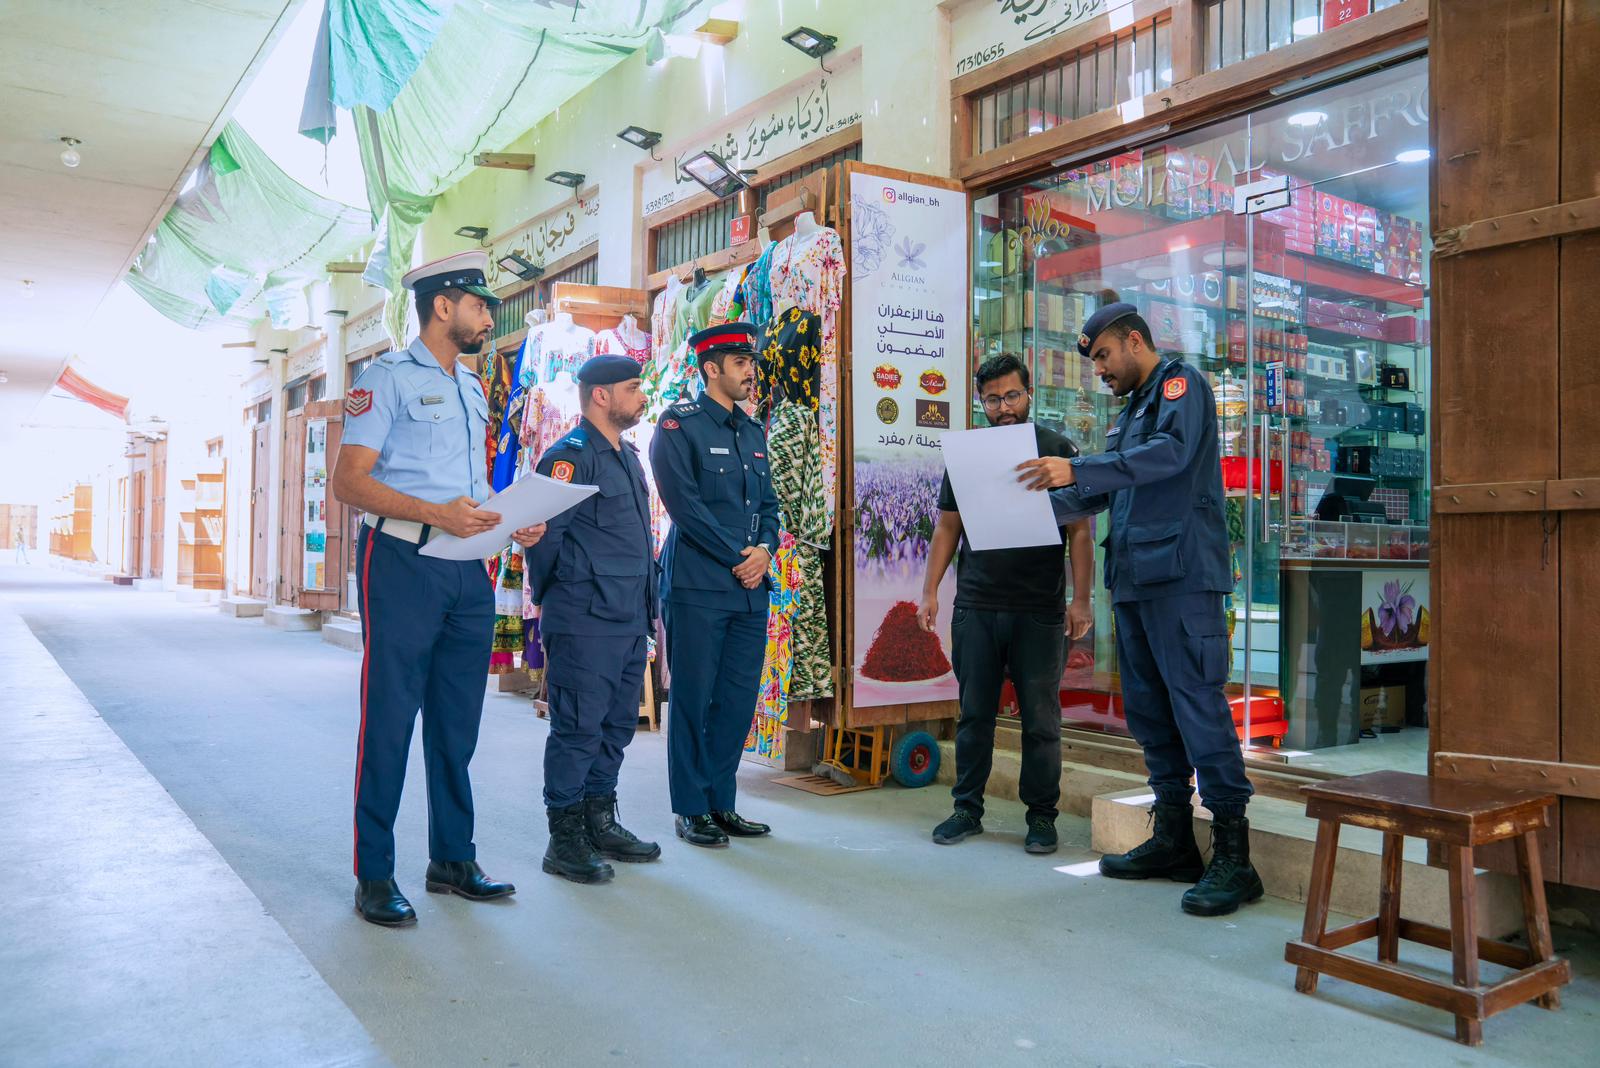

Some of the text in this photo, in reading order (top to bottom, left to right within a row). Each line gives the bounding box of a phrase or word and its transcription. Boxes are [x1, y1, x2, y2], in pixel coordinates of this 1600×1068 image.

[1339, 7, 1352, 21] 22
[956, 42, 1005, 75] 17310655
[898, 193, 940, 207] allgian_bh
[891, 272, 925, 284] ALLGIAN
[878, 304, 944, 323] هنا الزعفران
[877, 340, 944, 358] المضمون
[878, 432, 905, 446] مفرد
